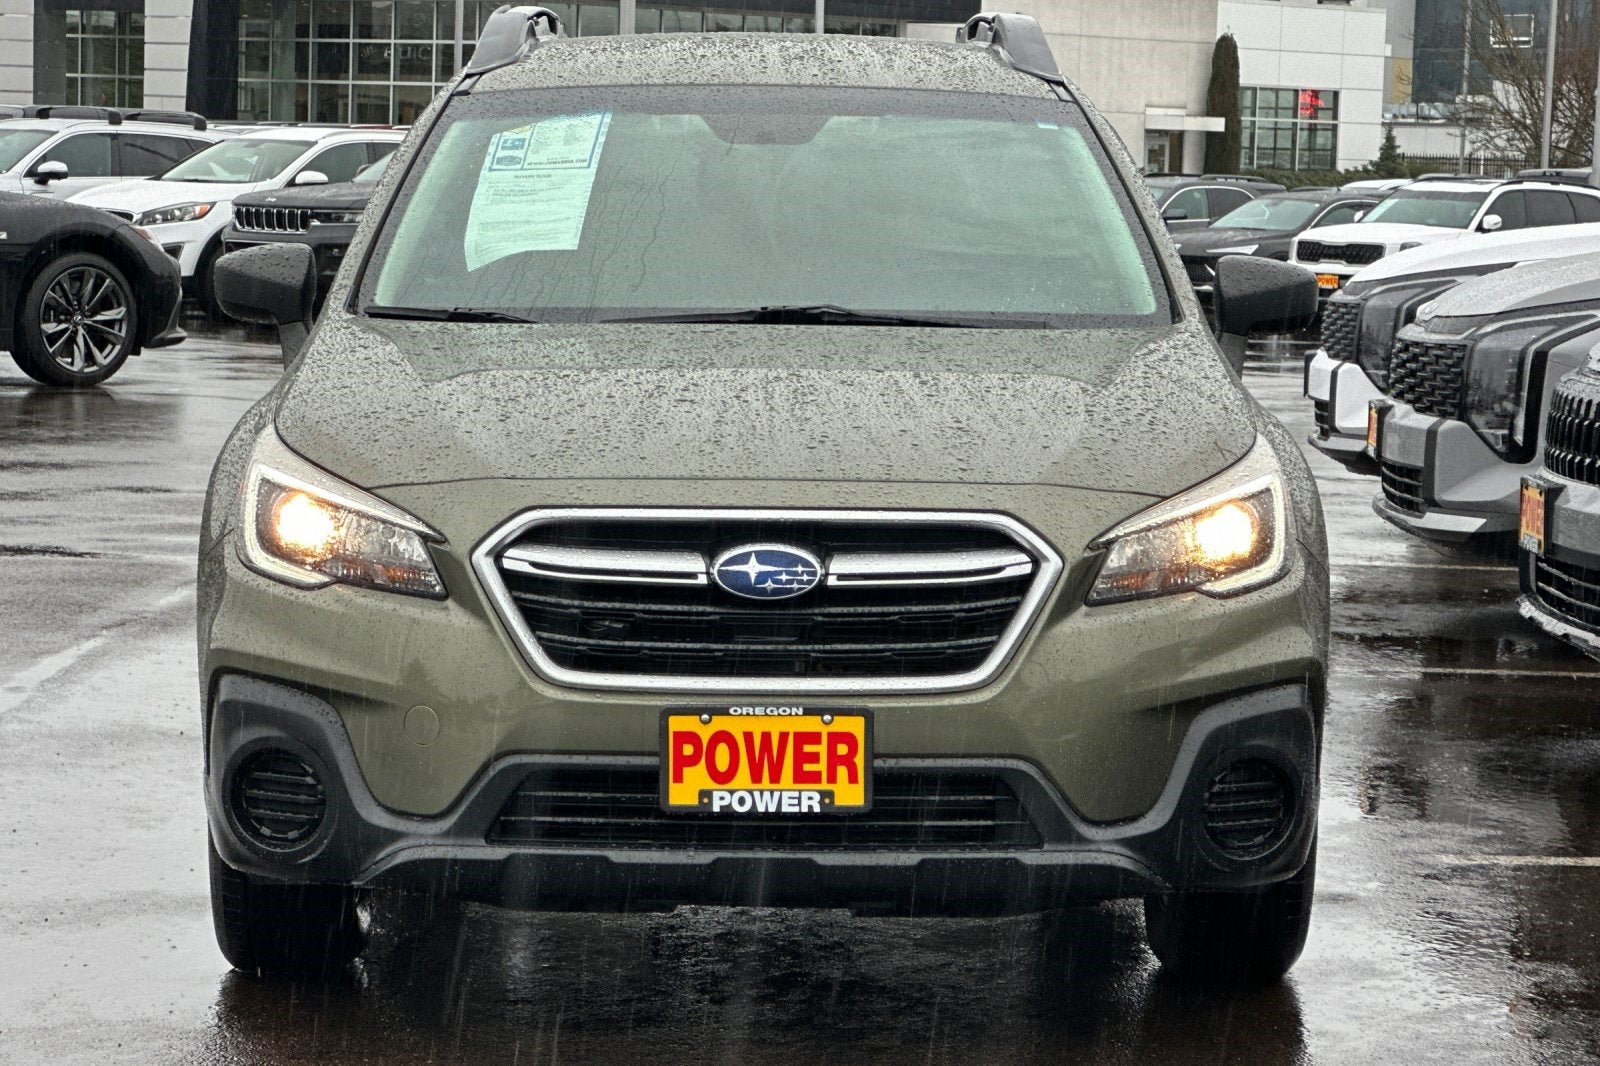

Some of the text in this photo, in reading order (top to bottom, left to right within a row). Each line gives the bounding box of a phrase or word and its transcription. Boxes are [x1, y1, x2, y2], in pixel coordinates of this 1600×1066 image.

[1317, 276, 1338, 285] POWER
[728, 706, 804, 716] OREGON
[672, 729, 859, 785] POWER
[712, 790, 821, 813] POWER
